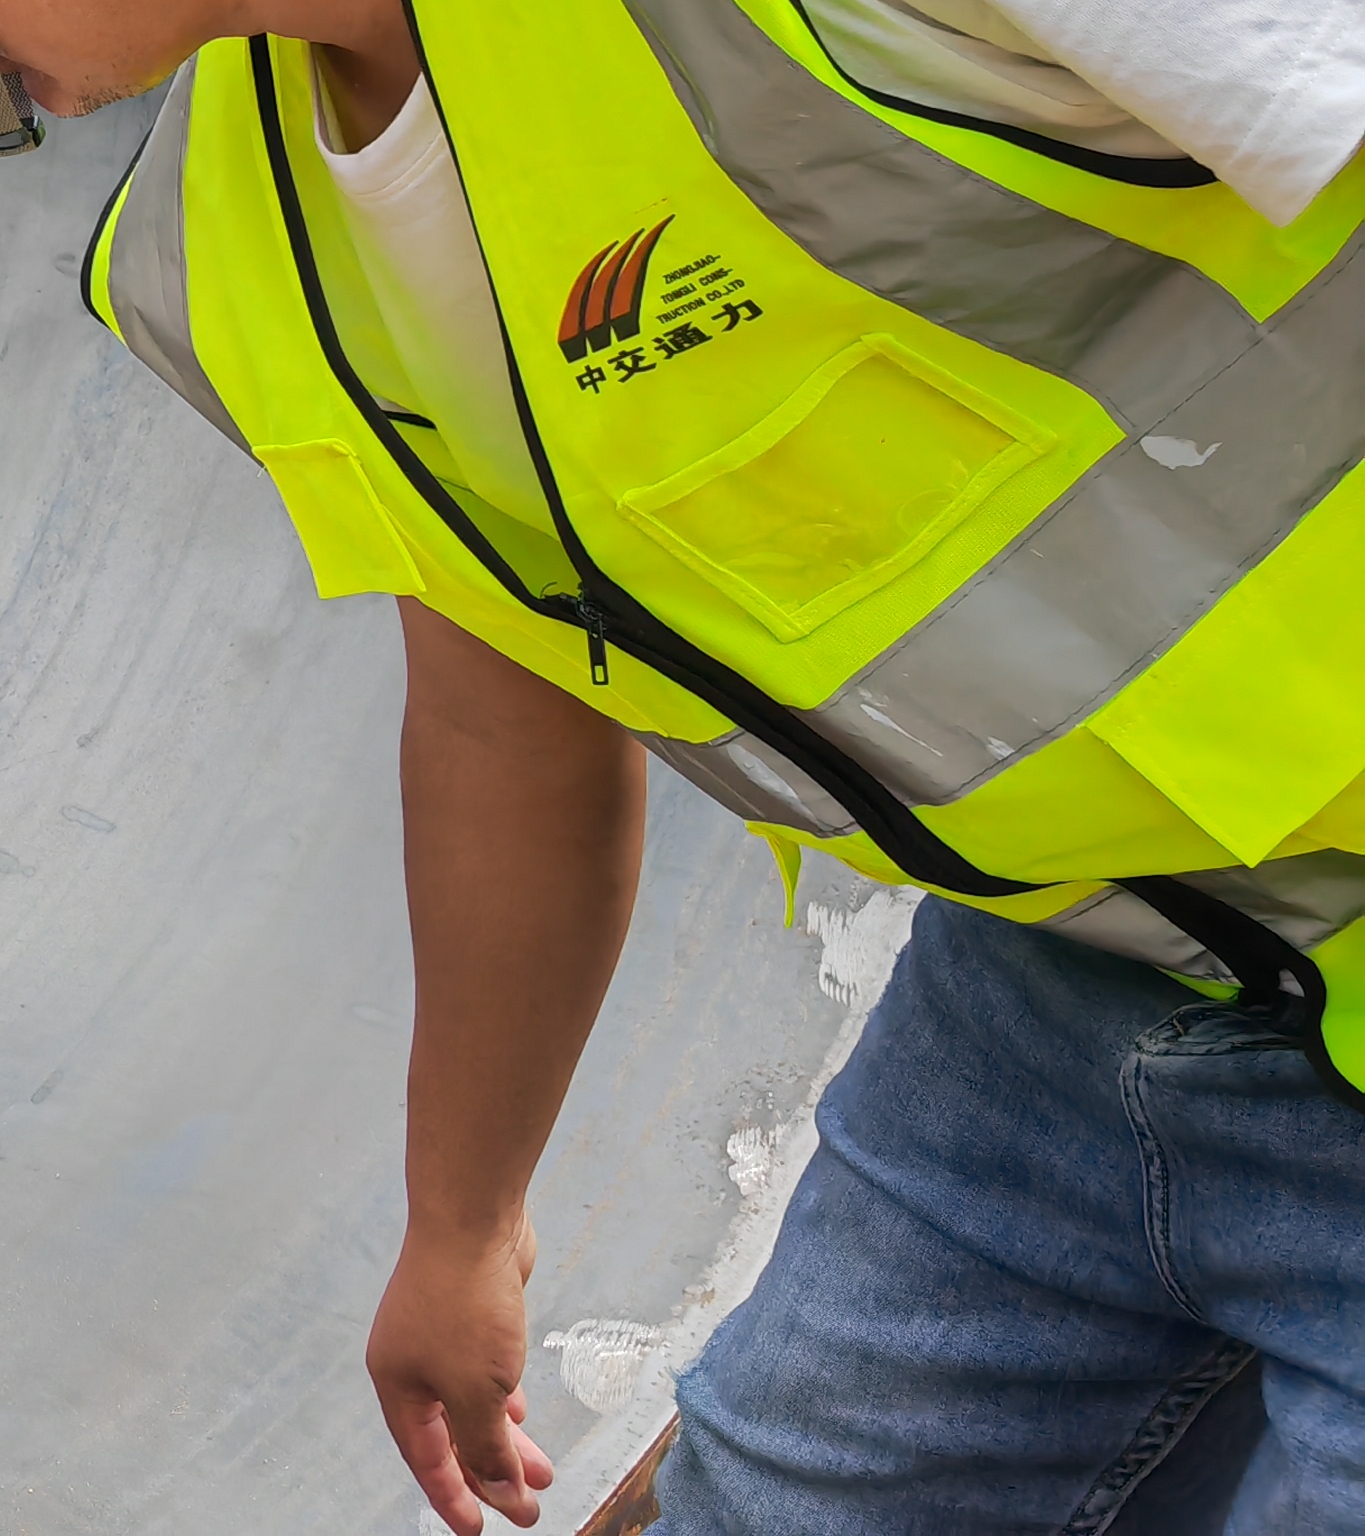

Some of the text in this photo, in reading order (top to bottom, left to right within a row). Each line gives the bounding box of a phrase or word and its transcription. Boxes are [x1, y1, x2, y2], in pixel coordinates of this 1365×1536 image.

[656, 297, 707, 325] TRUCTION
[575, 298, 763, 394] 中交通力
